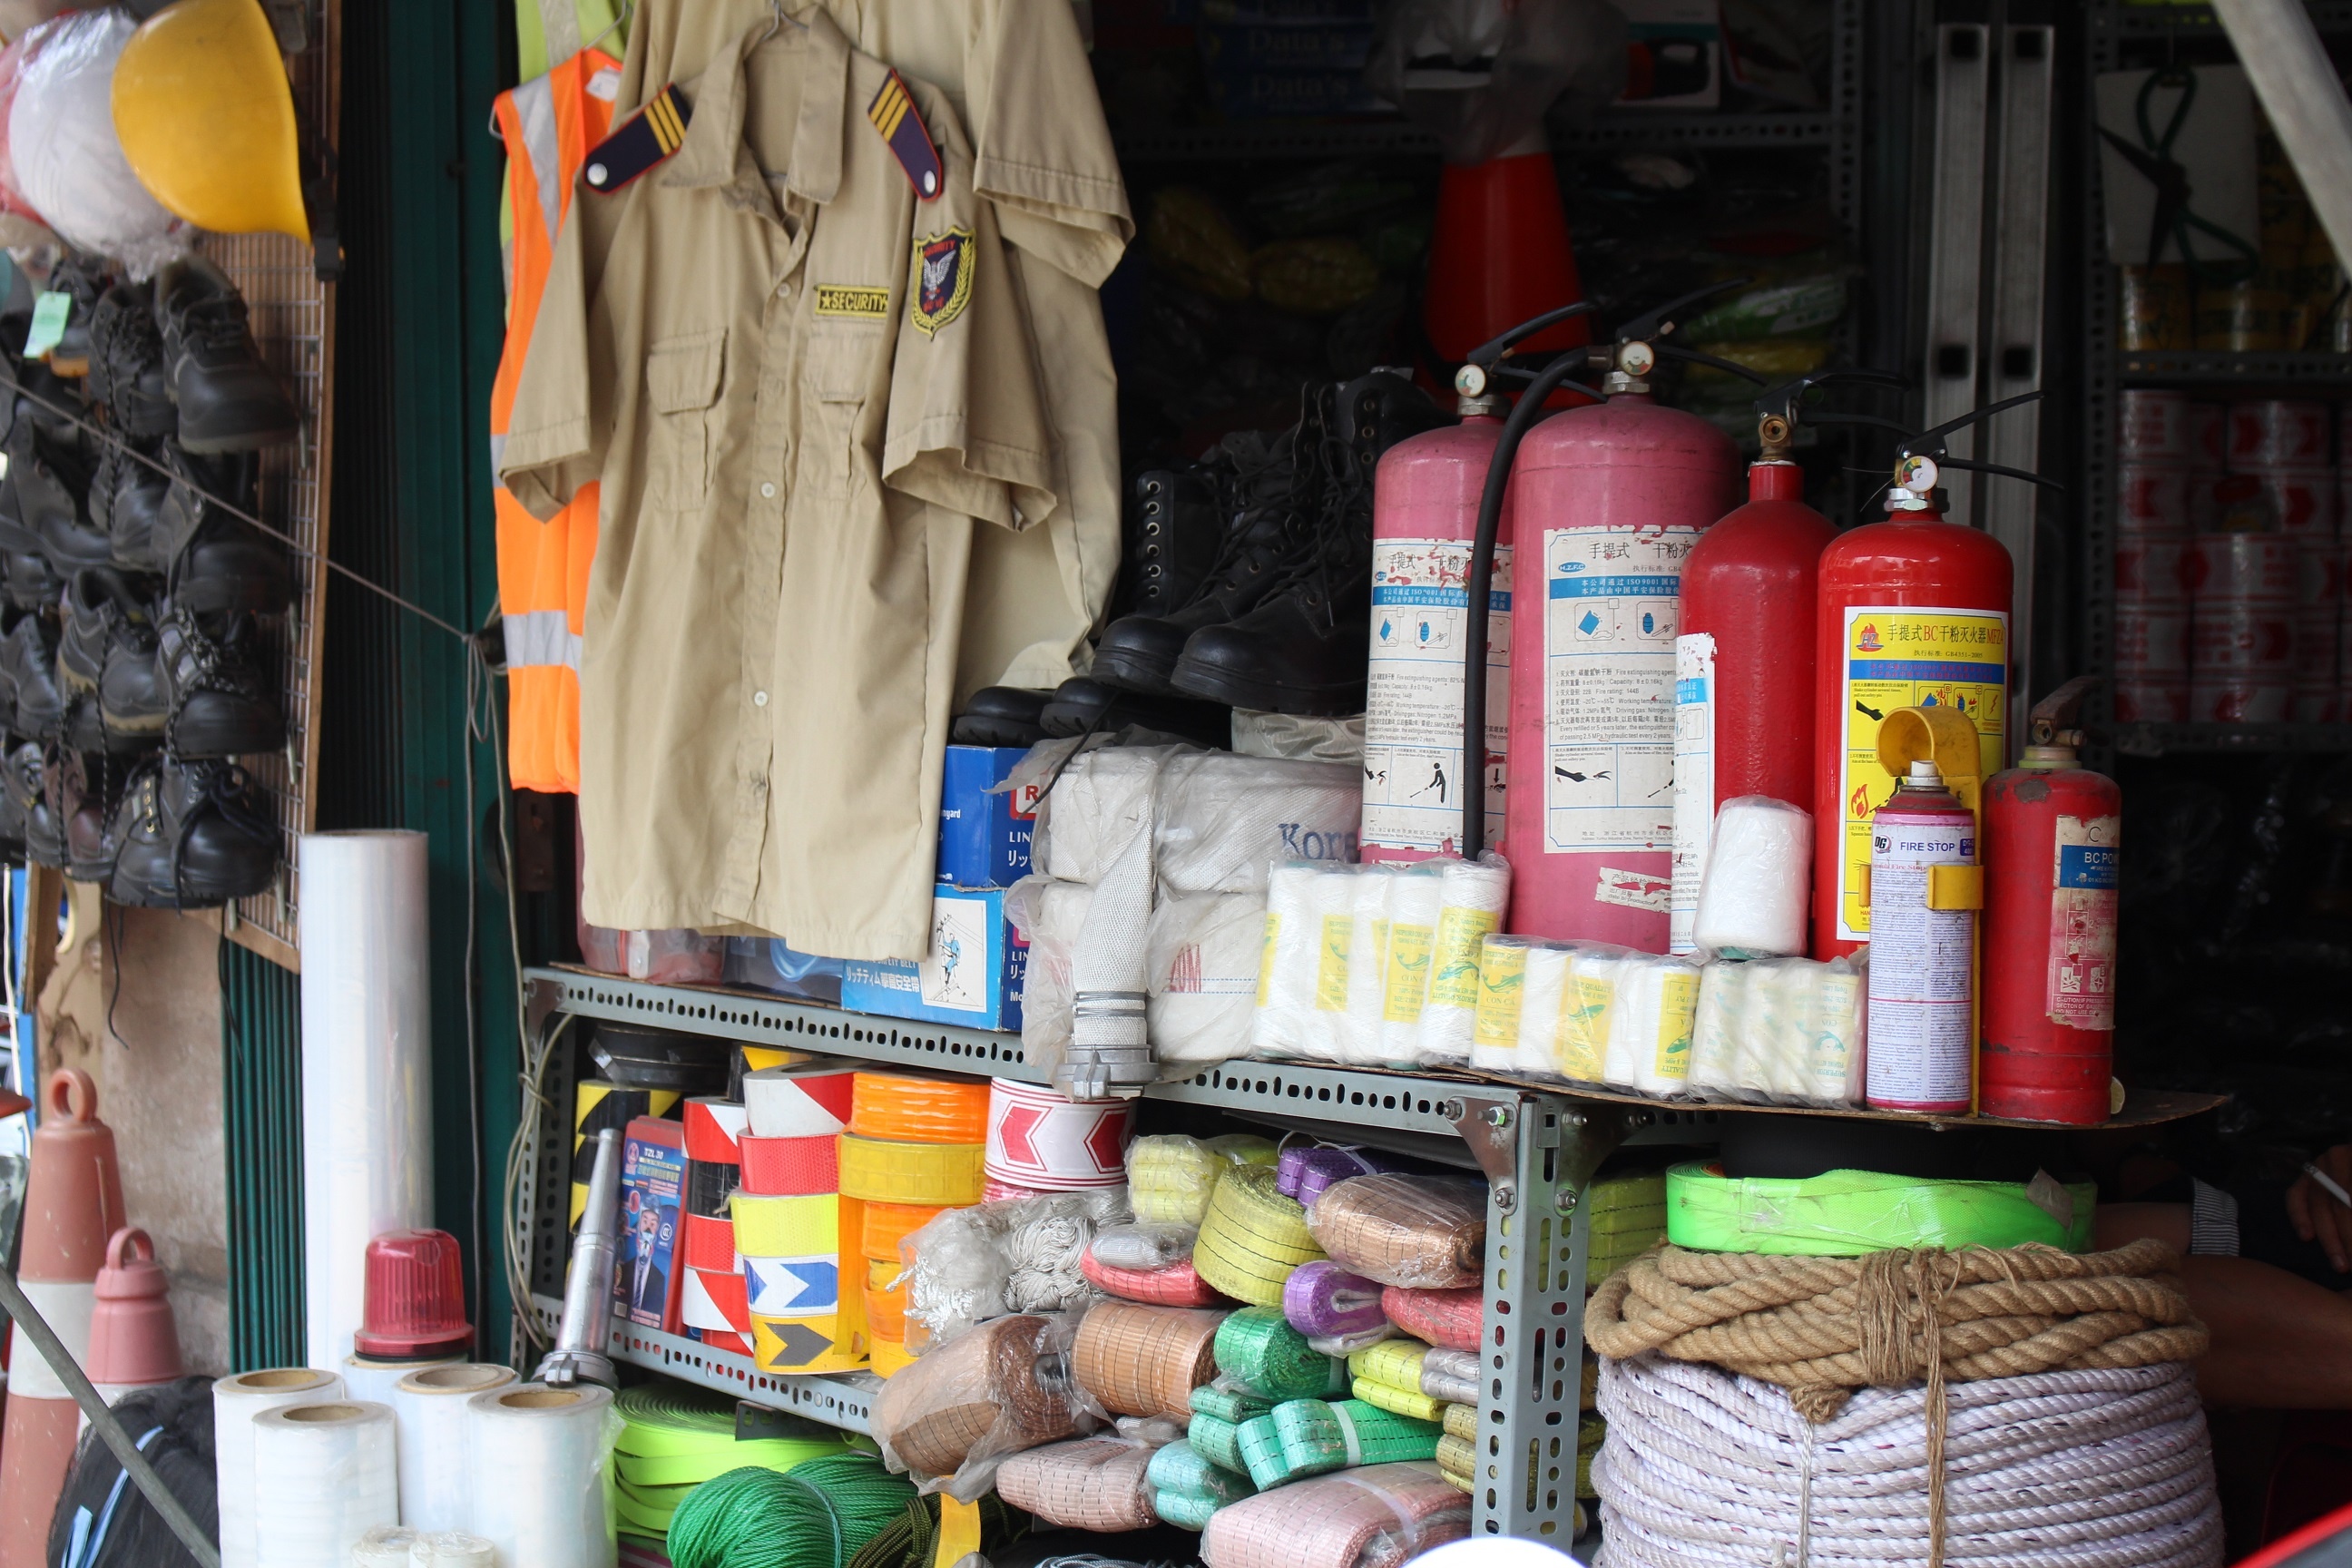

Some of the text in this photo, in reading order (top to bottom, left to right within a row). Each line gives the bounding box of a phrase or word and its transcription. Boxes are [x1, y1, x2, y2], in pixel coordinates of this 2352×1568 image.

[832, 291, 886, 311] SECURITY
[1589, 542, 1630, 559] 手提式
[2089, 827, 2102, 842] C
[1875, 837, 1887, 849] DG
[1900, 842, 1955, 852] FIRE STOP
[2084, 852, 2100, 863] BC
